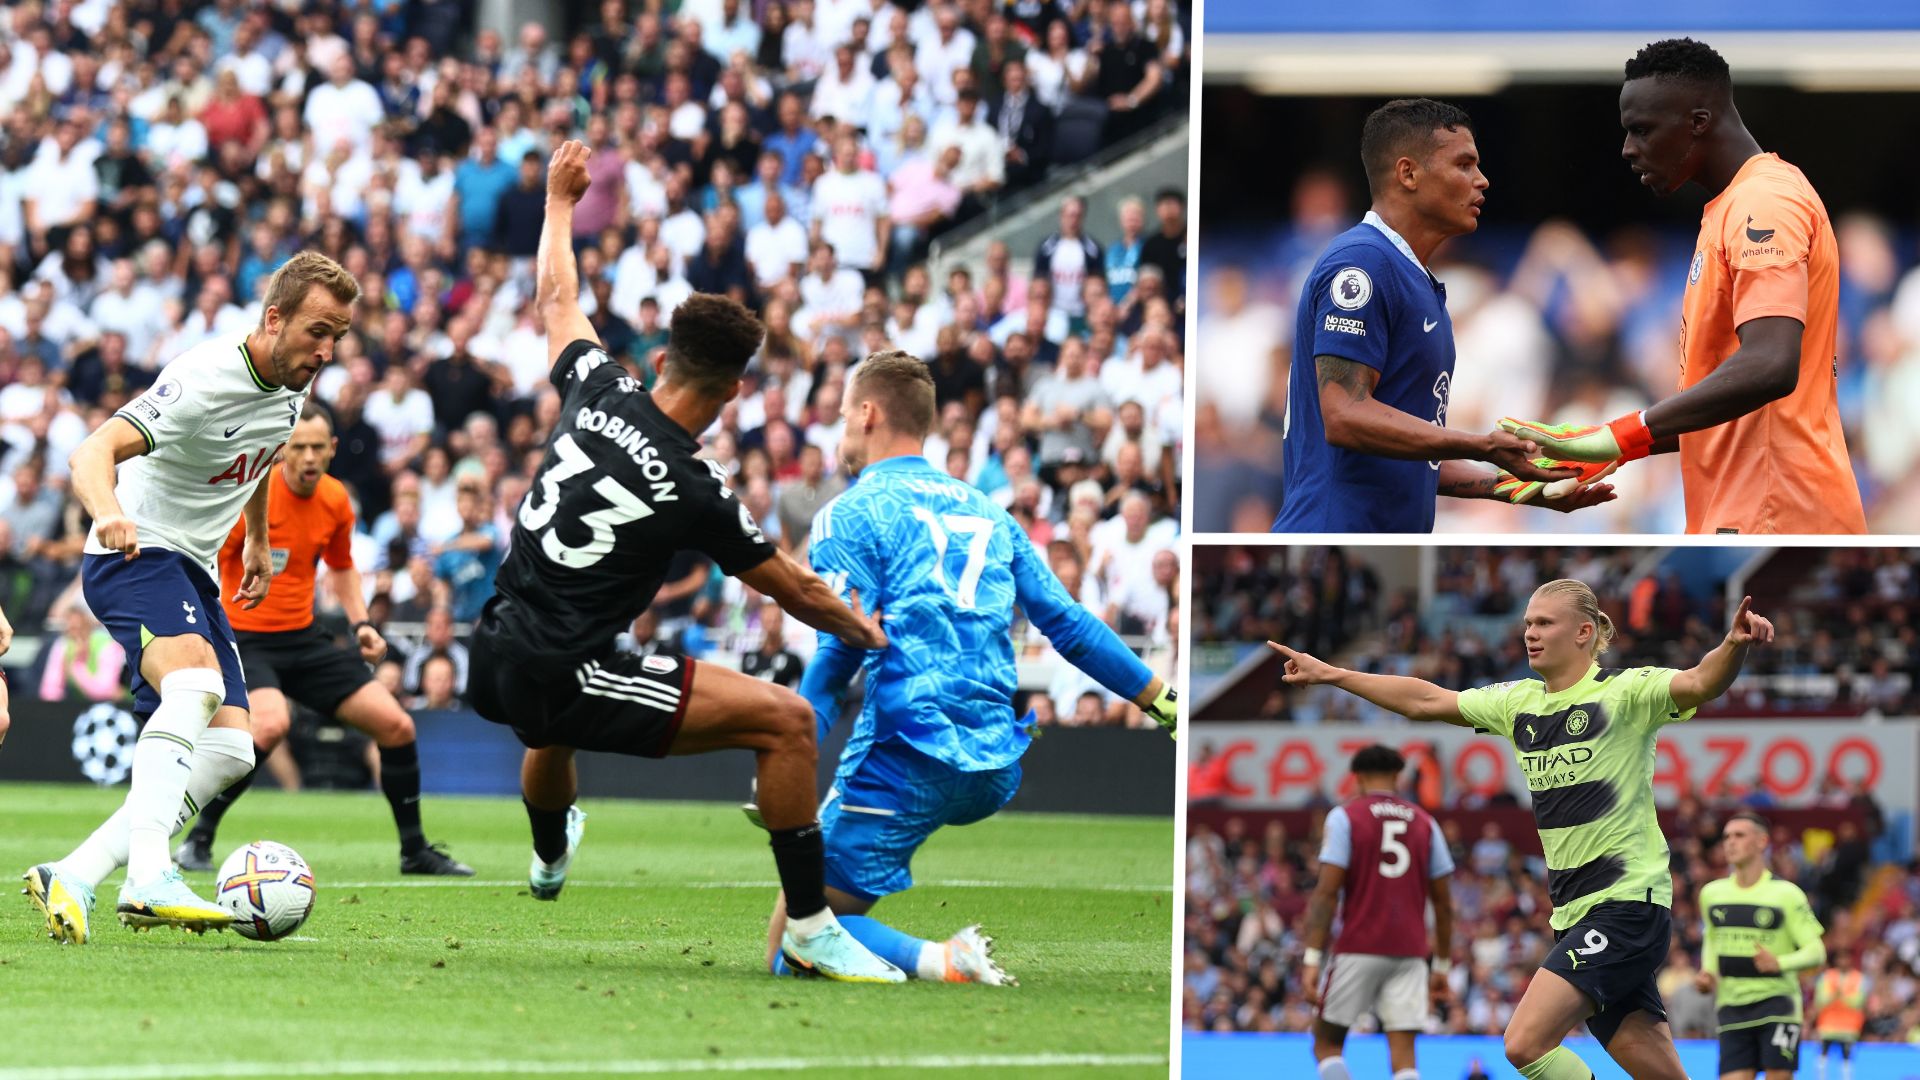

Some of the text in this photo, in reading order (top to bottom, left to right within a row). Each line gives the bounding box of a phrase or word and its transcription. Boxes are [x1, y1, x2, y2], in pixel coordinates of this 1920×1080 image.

[1741, 247, 1784, 258] WhaleFin
[1324, 323, 1366, 336] for racism
[1325, 314, 1364, 328] No room
[575, 407, 679, 502] ROBINSON
[518, 433, 655, 569] 33
[911, 506, 995, 609] 17
[1522, 747, 1593, 772] TIHAD
[1653, 737, 1882, 797] AZOO
[1379, 820, 1411, 878] 5
[1574, 929, 1609, 956] 9
[1771, 1023, 1800, 1051] 47
